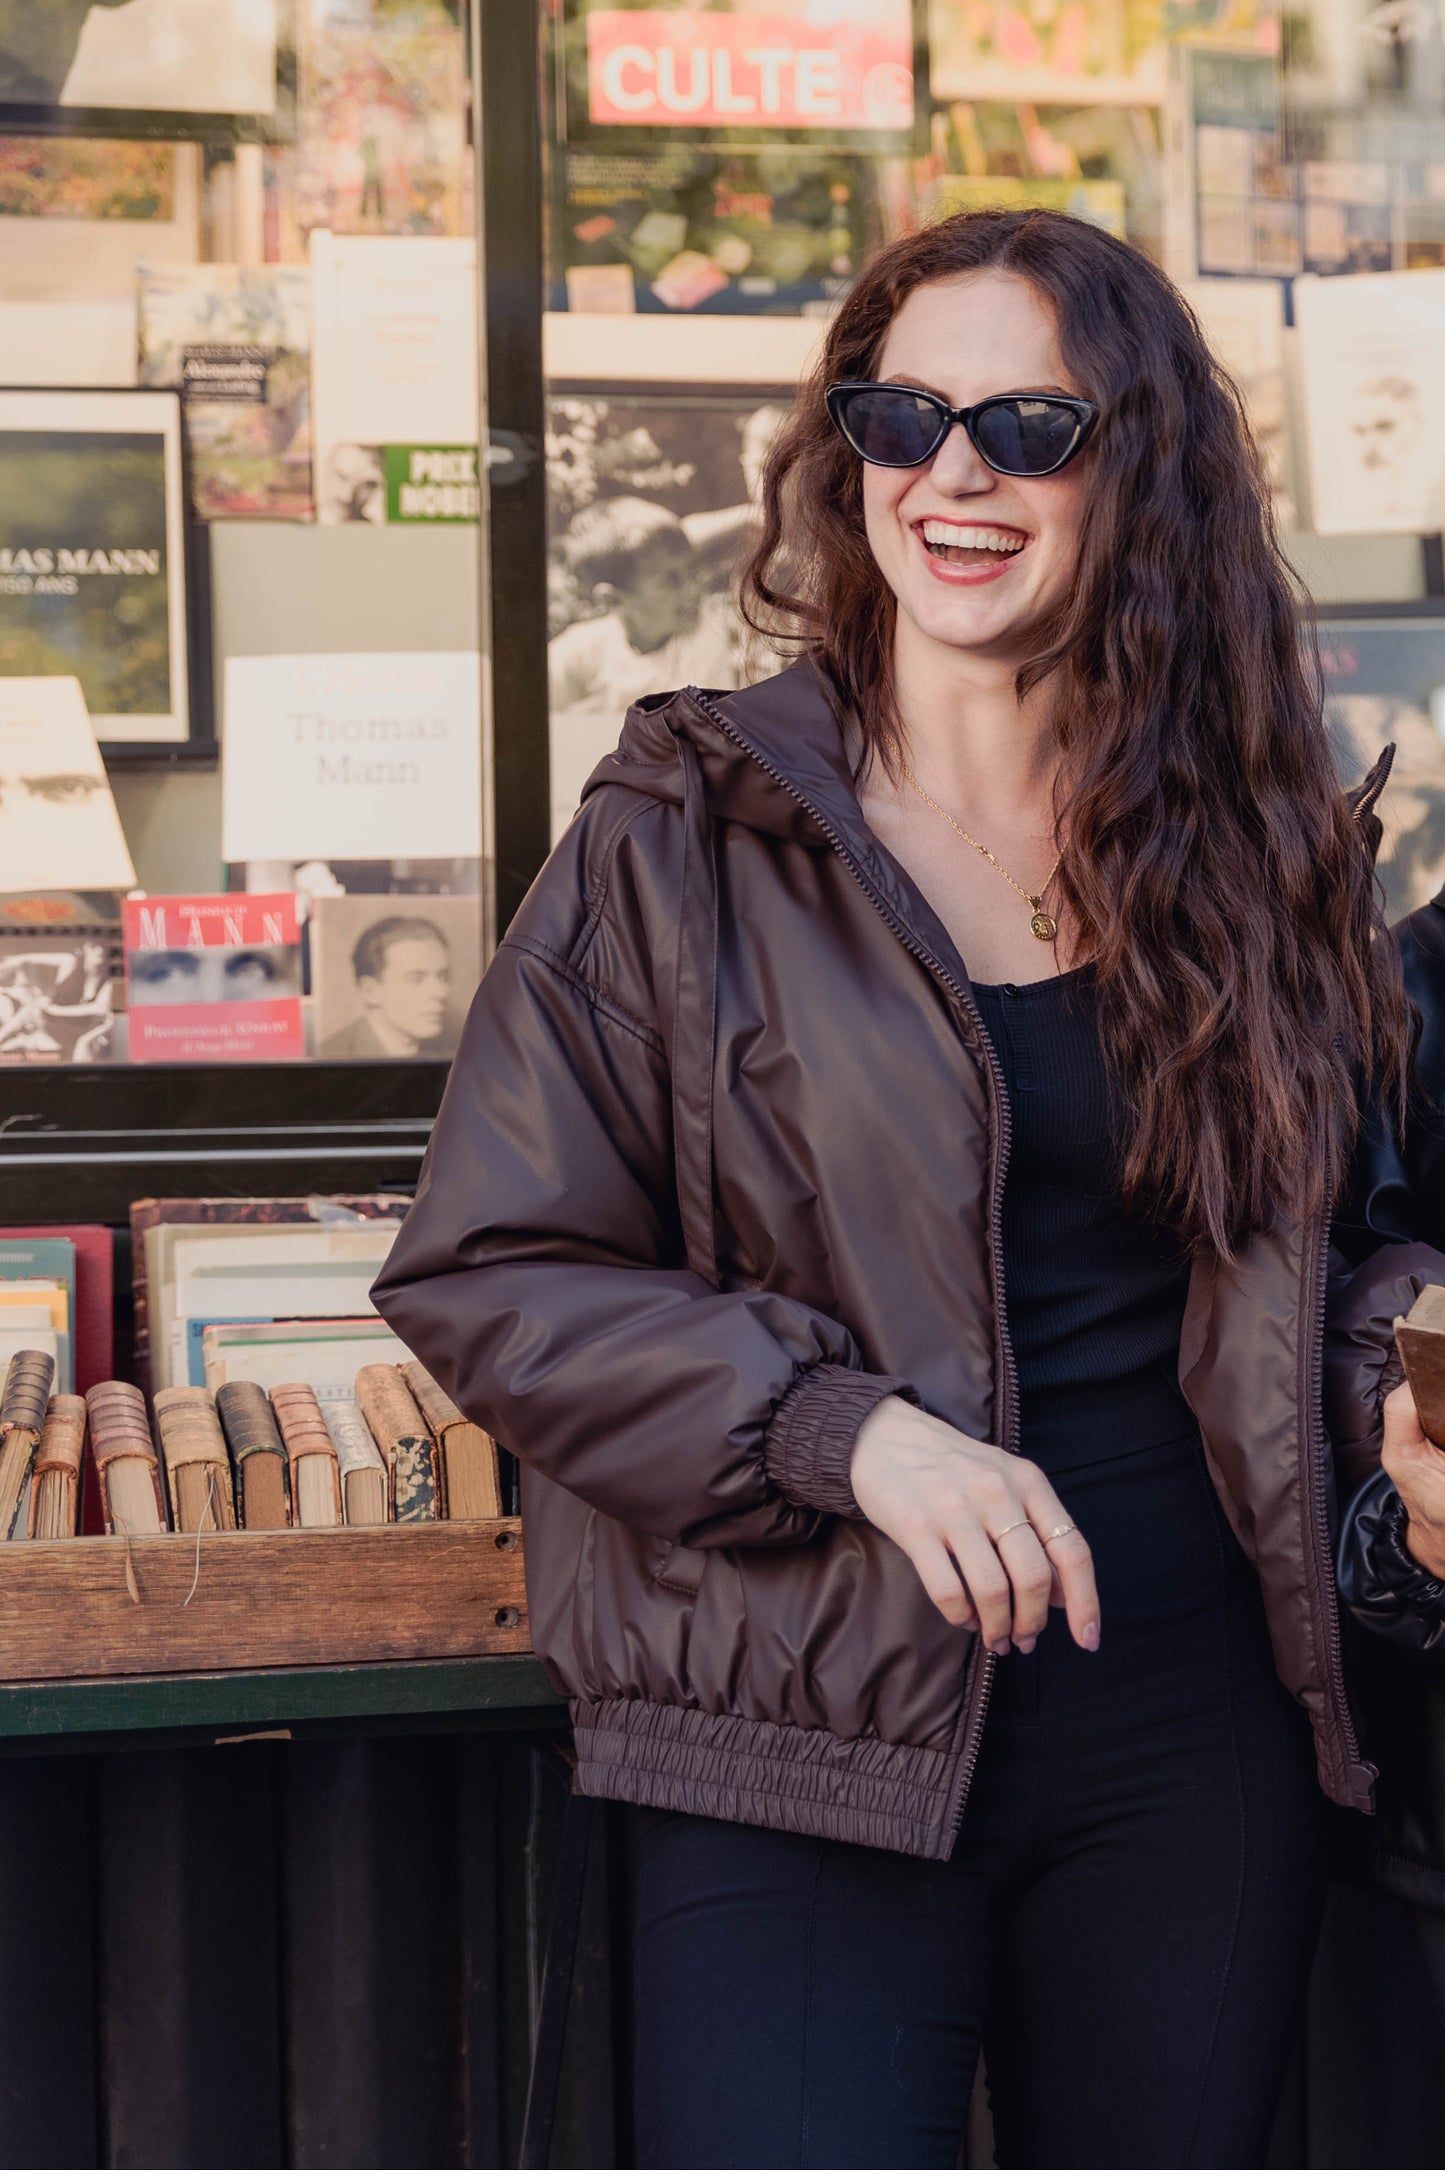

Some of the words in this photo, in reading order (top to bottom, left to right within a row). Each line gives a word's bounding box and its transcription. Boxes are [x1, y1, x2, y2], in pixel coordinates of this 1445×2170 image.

[601, 45, 840, 116] CULTE
[57, 548, 160, 575] MANN
[286, 712, 450, 743] Thomas
[314, 753, 421, 786] Mann
[139, 907, 283, 949] MANN
